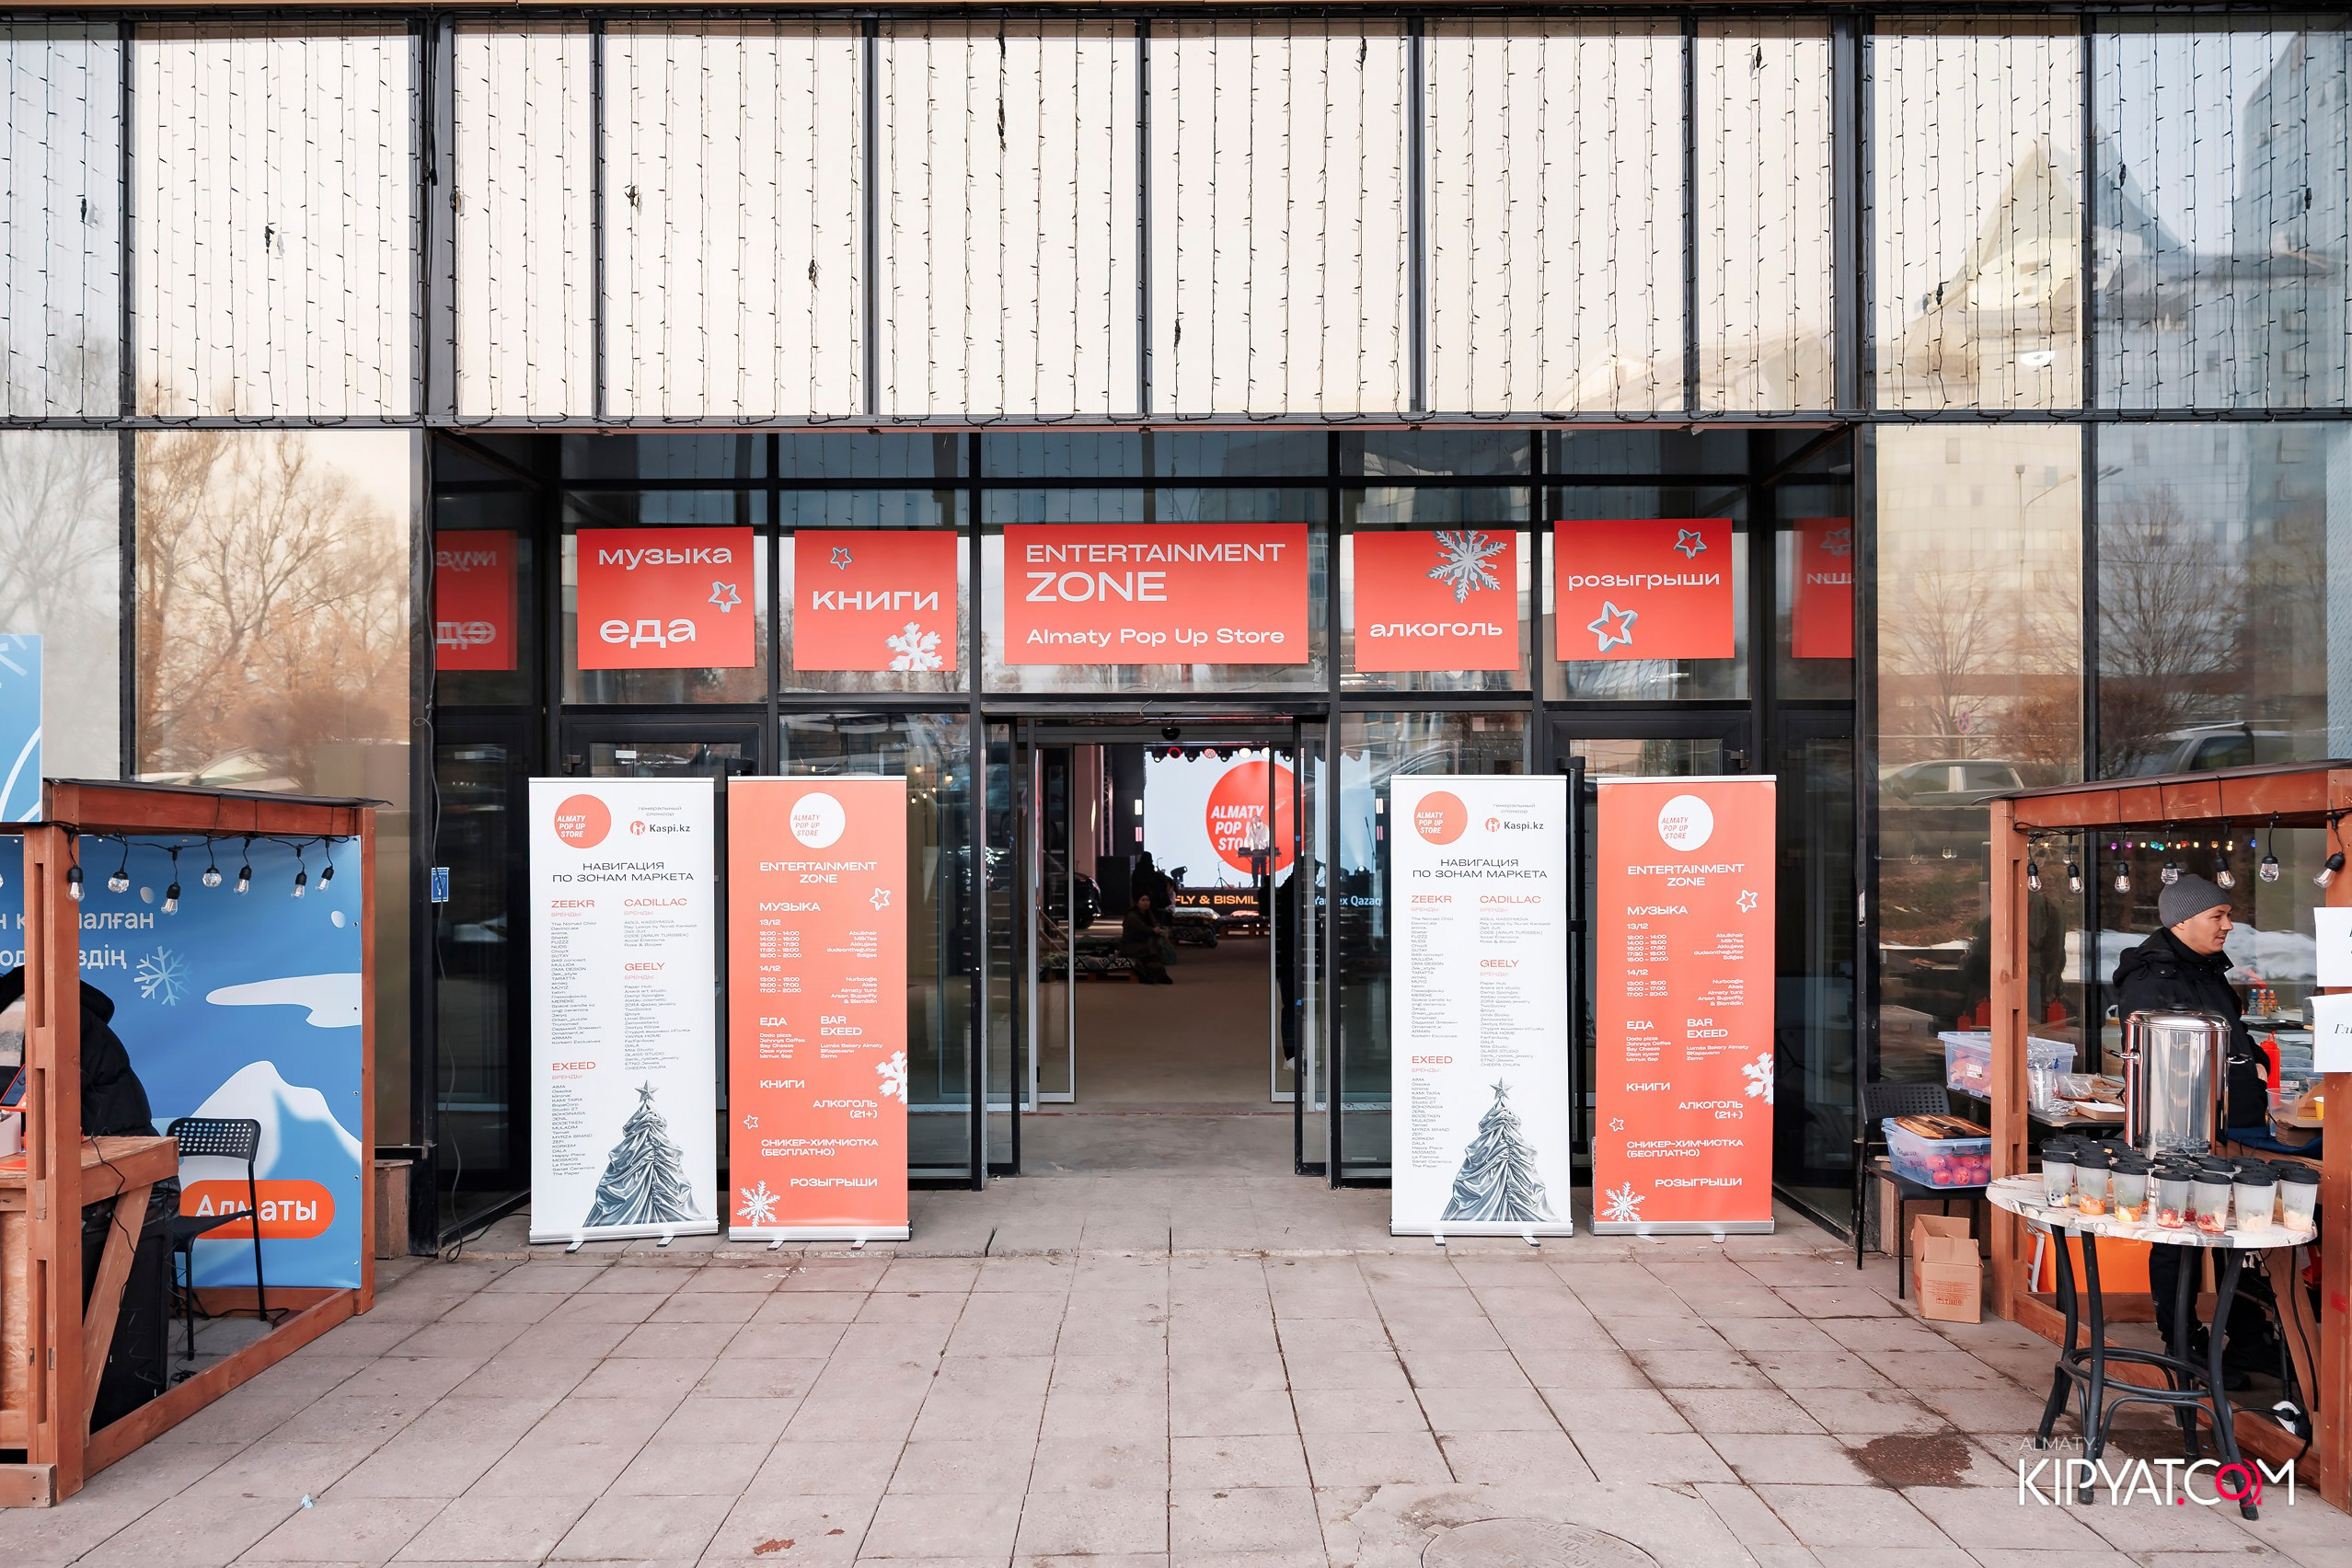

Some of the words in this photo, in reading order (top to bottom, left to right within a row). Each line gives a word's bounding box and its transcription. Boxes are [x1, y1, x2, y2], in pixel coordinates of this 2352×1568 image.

[1027, 543, 1286, 562] ENTERTAINMENT
[599, 548, 732, 570] музыка
[1569, 574, 1719, 590] розыгрыши
[1026, 572, 1167, 602] ZONE
[813, 591, 939, 610] книги
[600, 619, 696, 648] еда
[1370, 623, 1503, 637] алкоголь
[1027, 629, 1112, 647] Almaty
[1121, 628, 1166, 647] Pop
[1175, 628, 1207, 647] Up
[1216, 628, 1285, 643] Store
[1211, 806, 1264, 818] ALMATY
[649, 824, 690, 834] Kaspi.kz
[1215, 822, 1242, 834] POP
[1504, 821, 1544, 830] Kaspi.kz
[582, 862, 664, 870] НАВИГАЦИЯ
[759, 861, 877, 871] ENTERTAINMENT
[1440, 859, 1519, 868] НАВИГАЦИЯ
[1628, 864, 1745, 875] ENTERTAINMENT
[552, 874, 572, 882] ПО
[576, 873, 627, 882] ЗОНАМ
[631, 872, 694, 882] МАРКЕТА
[800, 874, 837, 883] ZONE
[1486, 870, 1547, 879] МАРКЕТА
[1667, 877, 1706, 887] ZONE
[551, 900, 595, 908] ZEEKR
[624, 898, 687, 906] CADILLAC
[1199, 895, 1210, 904] &
[1411, 895, 1452, 904] ZEEKR
[1480, 895, 1541, 904] CADILLAC
[759, 902, 821, 912] МУЗЫКА
[1627, 905, 1689, 916] МУЗЫКА
[624, 963, 664, 971] GEELY
[1480, 960, 1519, 968] GEELY
[760, 1018, 788, 1027] ЕДА
[820, 1015, 847, 1024] BAR
[1687, 1018, 1713, 1027] BAR
[1626, 1020, 1654, 1031] ЕДА
[820, 1027, 863, 1036] EXEED
[1687, 1029, 1728, 1038] EXEED
[1412, 1055, 1453, 1064] EXEED
[552, 1061, 596, 1071] EXEED
[760, 1080, 805, 1089] КНИГИ
[1626, 1082, 1671, 1091] КНИГИ
[813, 1100, 878, 1108] АЛКОГОЛЬ
[1678, 1101, 1743, 1110] АЛКОГОЛЬ
[849, 1110, 878, 1119] (21+)
[1714, 1111, 1743, 1120] (21+)
[1627, 1139, 1744, 1148] СНИКЕР-ХИМЧИСТКА
[761, 1147, 835, 1157] (БЕСПЛАТНО)
[1627, 1149, 1701, 1159] (БЕСПЛАТНО)
[790, 1178, 878, 1187] РОЗЫГРЫШИ
[1655, 1178, 1742, 1188] РОЗЫГРЫШИ
